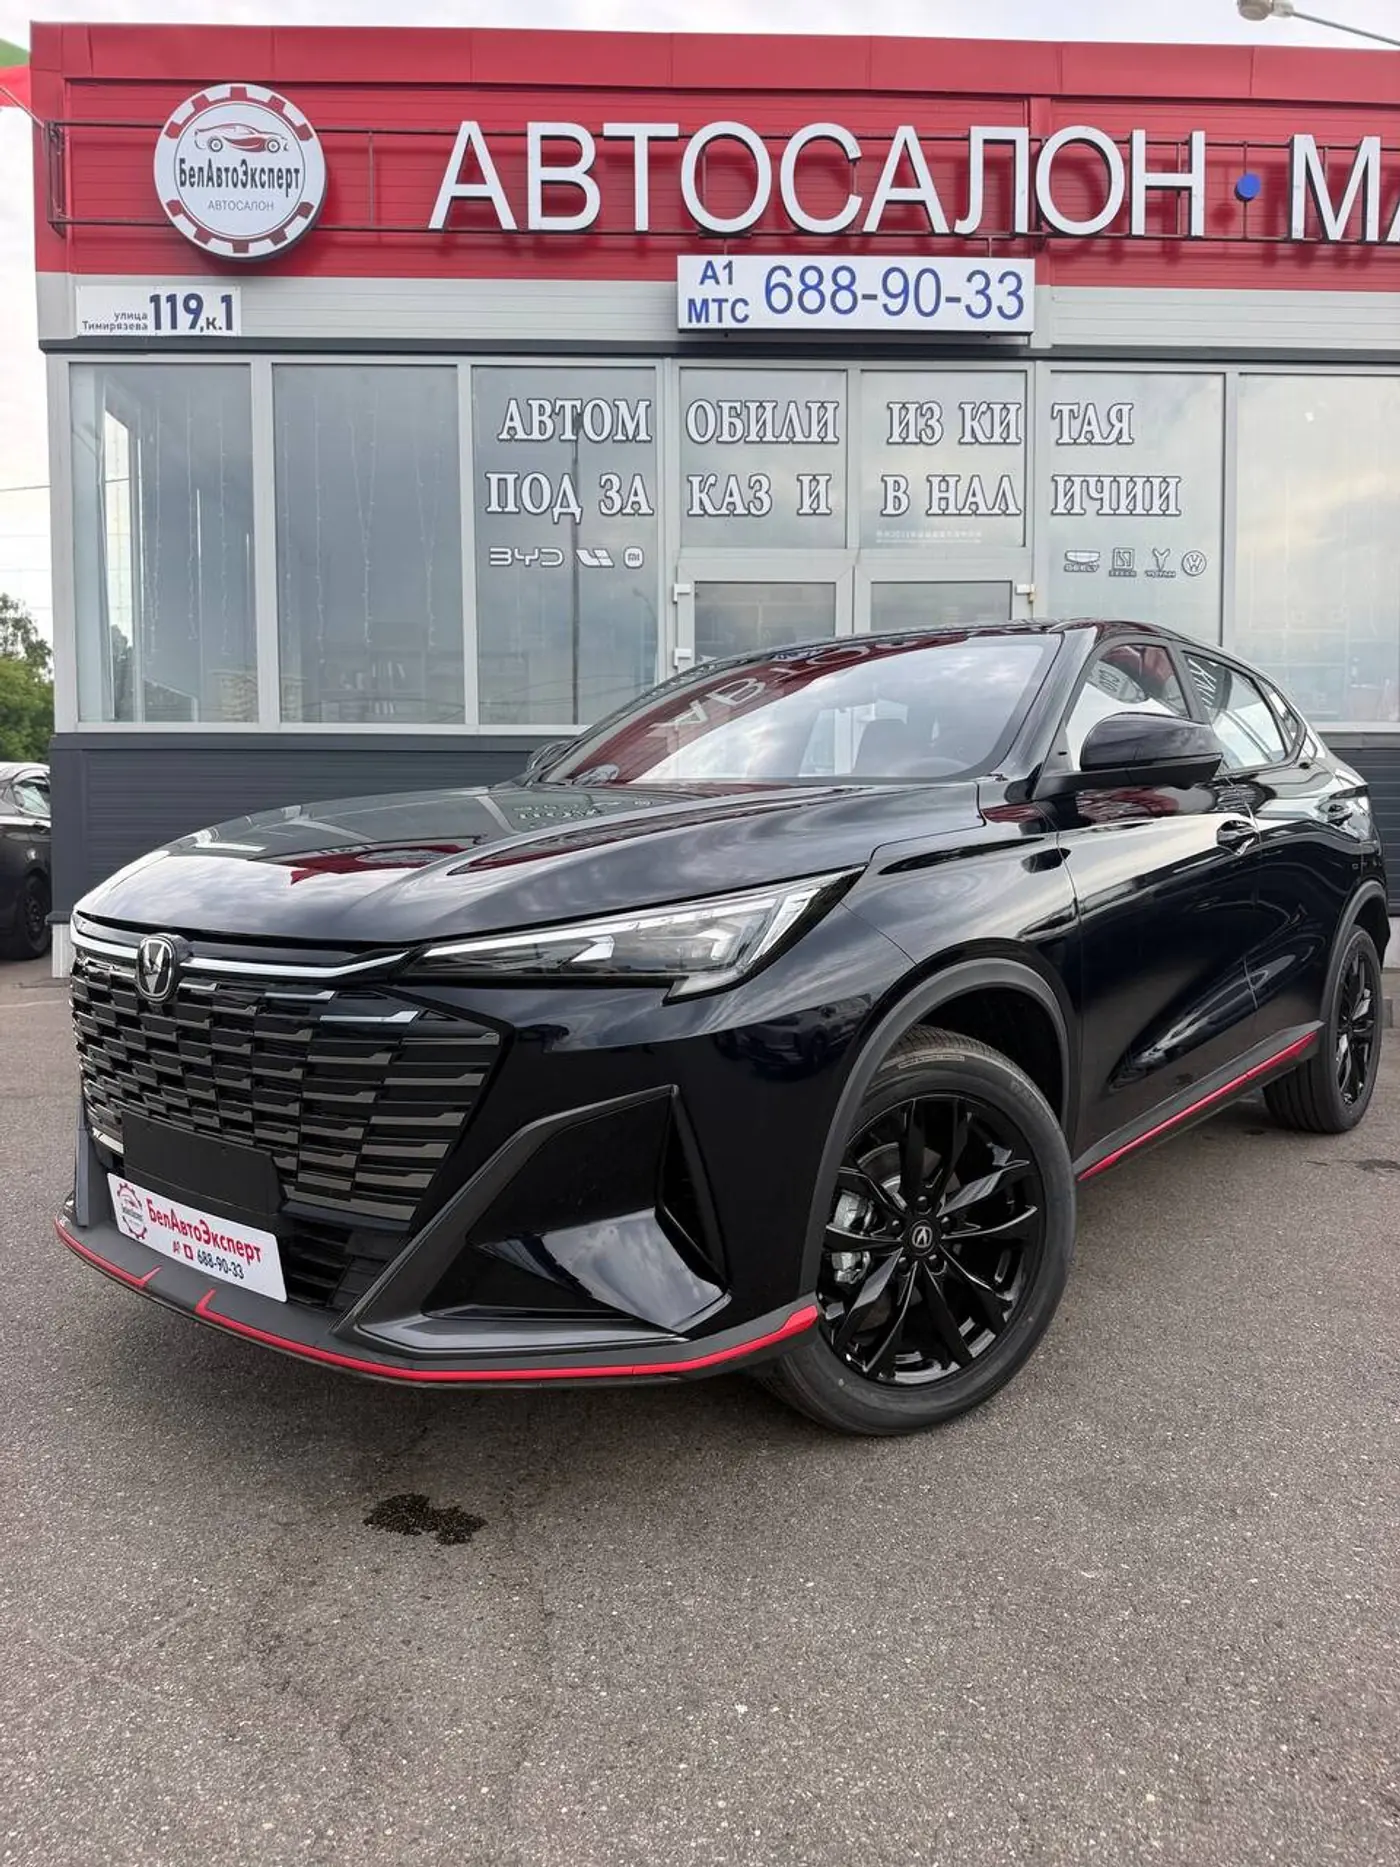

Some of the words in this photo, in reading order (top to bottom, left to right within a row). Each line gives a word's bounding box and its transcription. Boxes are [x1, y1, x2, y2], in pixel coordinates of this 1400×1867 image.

[179, 158, 300, 198] БелАвтоЭксперт
[427, 120, 1206, 238] АВТОСАЛОН
[1290, 134, 1400, 242] М
[208, 200, 274, 211] АВТОСАЛОН
[699, 260, 734, 286] А1
[765, 265, 1025, 320] 688-90-33
[114, 311, 148, 321] улица
[687, 297, 750, 324] МТС
[82, 320, 148, 333] Тимирязева
[498, 398, 651, 442] АВТОМ
[686, 399, 840, 444] ОБИЛИ
[886, 400, 944, 445] ИЗ
[958, 401, 1022, 445] КИ
[1051, 402, 1134, 445] ТАЯ
[485, 472, 582, 524] ПОД
[598, 472, 654, 516] ЗА
[687, 473, 772, 517] КАЗ
[797, 474, 832, 516] И
[880, 474, 910, 517] В
[926, 474, 1022, 517] НАЛ
[1050, 475, 1182, 517] ИЧИИ
[489, 547, 564, 567] BYD
[146, 1197, 261, 1265] БелАвтоЭксперт
[197, 1249, 245, 1280] 688-90-33
